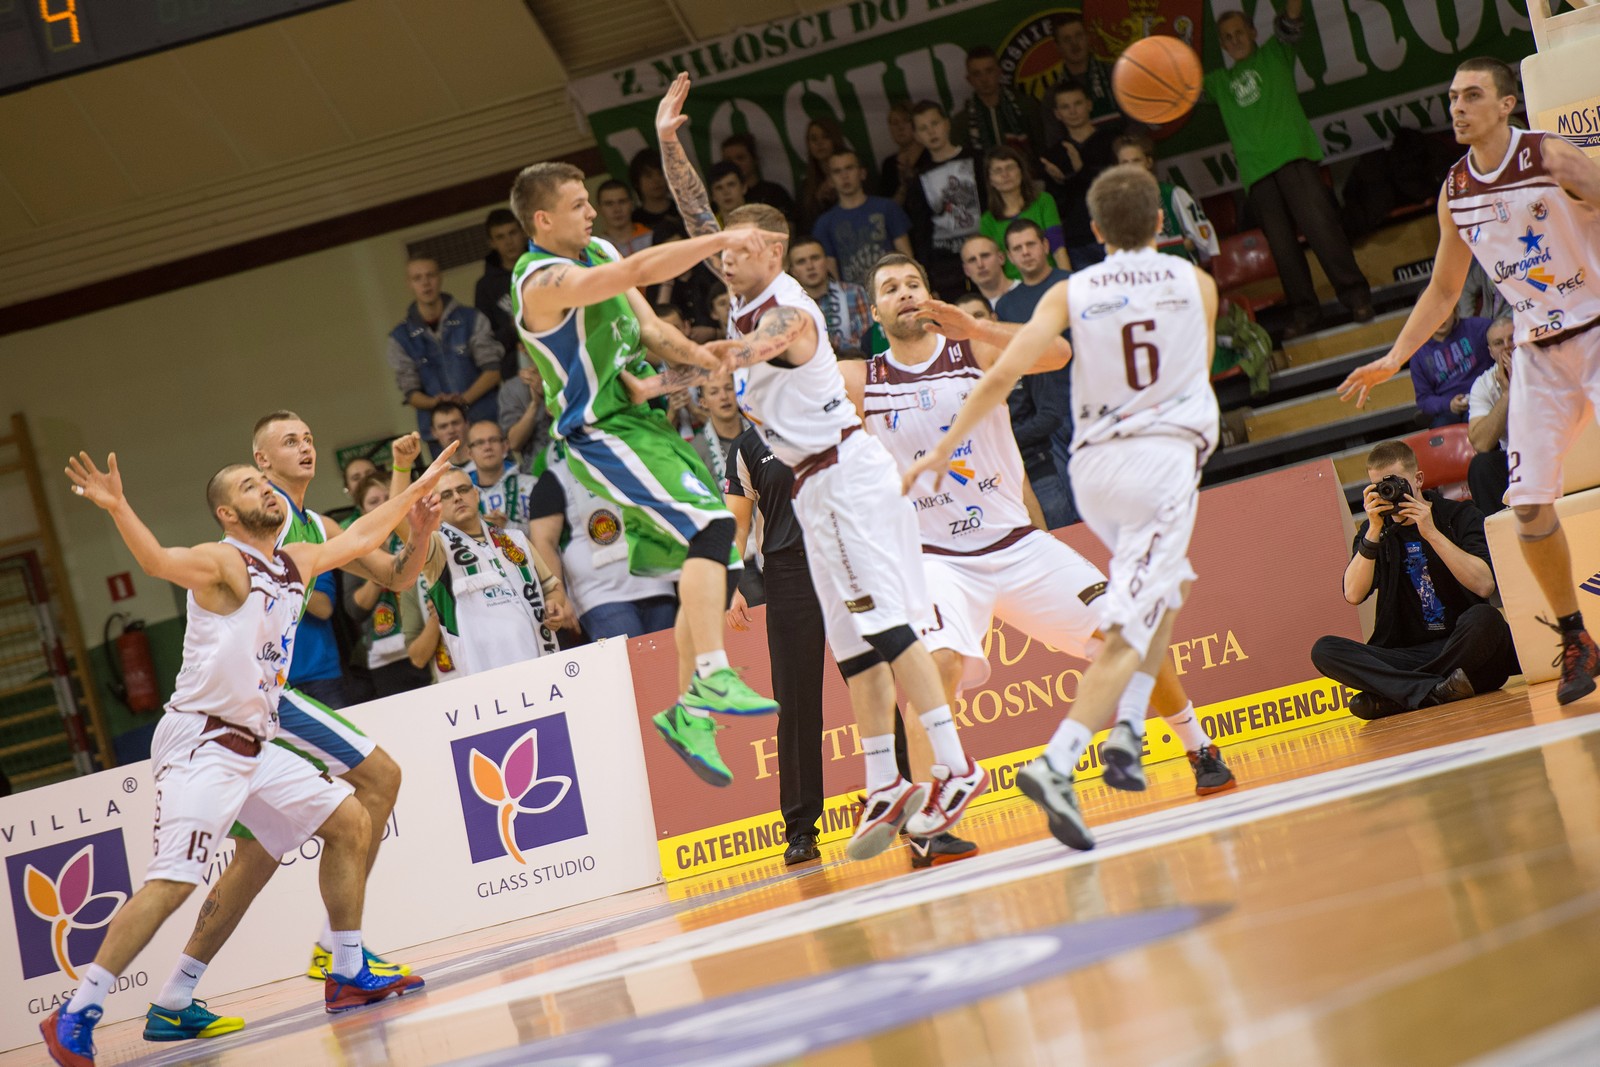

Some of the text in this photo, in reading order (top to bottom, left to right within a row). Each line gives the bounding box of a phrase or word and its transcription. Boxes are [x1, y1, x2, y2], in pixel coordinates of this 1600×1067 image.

[612, 67, 644, 97] Z
[1518, 147, 1533, 172] 12
[1089, 267, 1177, 288] SPÓJNIA
[1493, 246, 1552, 285] Stargard
[947, 342, 963, 363] 19
[1121, 318, 1160, 392] 6
[1509, 450, 1522, 484] 2
[948, 515, 981, 536] ZZO
[1169, 629, 1249, 677] FTA
[445, 683, 564, 727] VILLA
[954, 668, 1083, 731] ROSNO
[1200, 683, 1355, 741] ONFERENCJE
[1, 799, 121, 843] VILLA
[186, 829, 213, 864] 15
[675, 820, 788, 870] CATERING
[477, 855, 596, 898] GLASS STUDIO
[107, 970, 149, 995] UDIO
